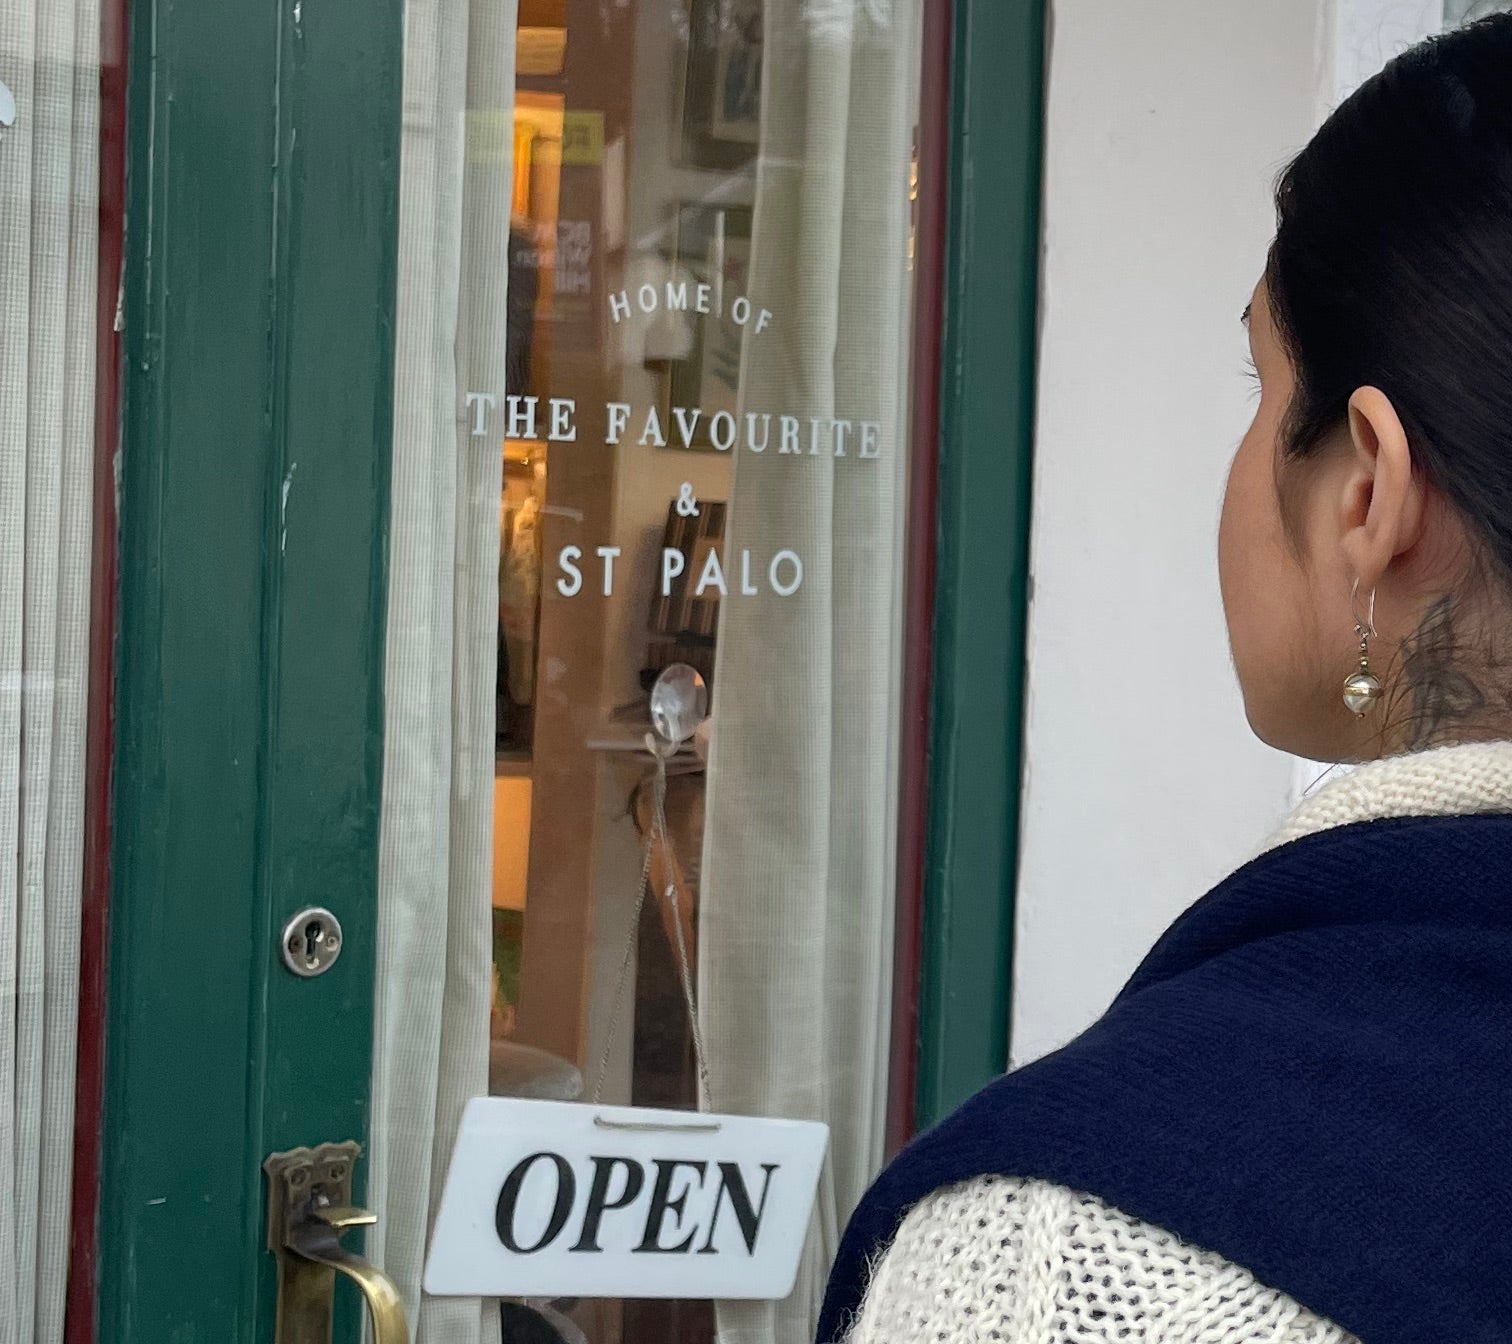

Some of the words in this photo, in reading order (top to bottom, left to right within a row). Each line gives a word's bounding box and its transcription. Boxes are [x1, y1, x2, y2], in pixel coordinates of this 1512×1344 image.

[609, 282, 711, 323] HOME
[732, 297, 773, 334] OF
[465, 391, 577, 442] THE
[605, 402, 882, 459] FAVOURITE
[676, 481, 699, 517] &
[556, 545, 621, 597] ST
[661, 547, 804, 597] PALO
[494, 1152, 781, 1256] OPEN
